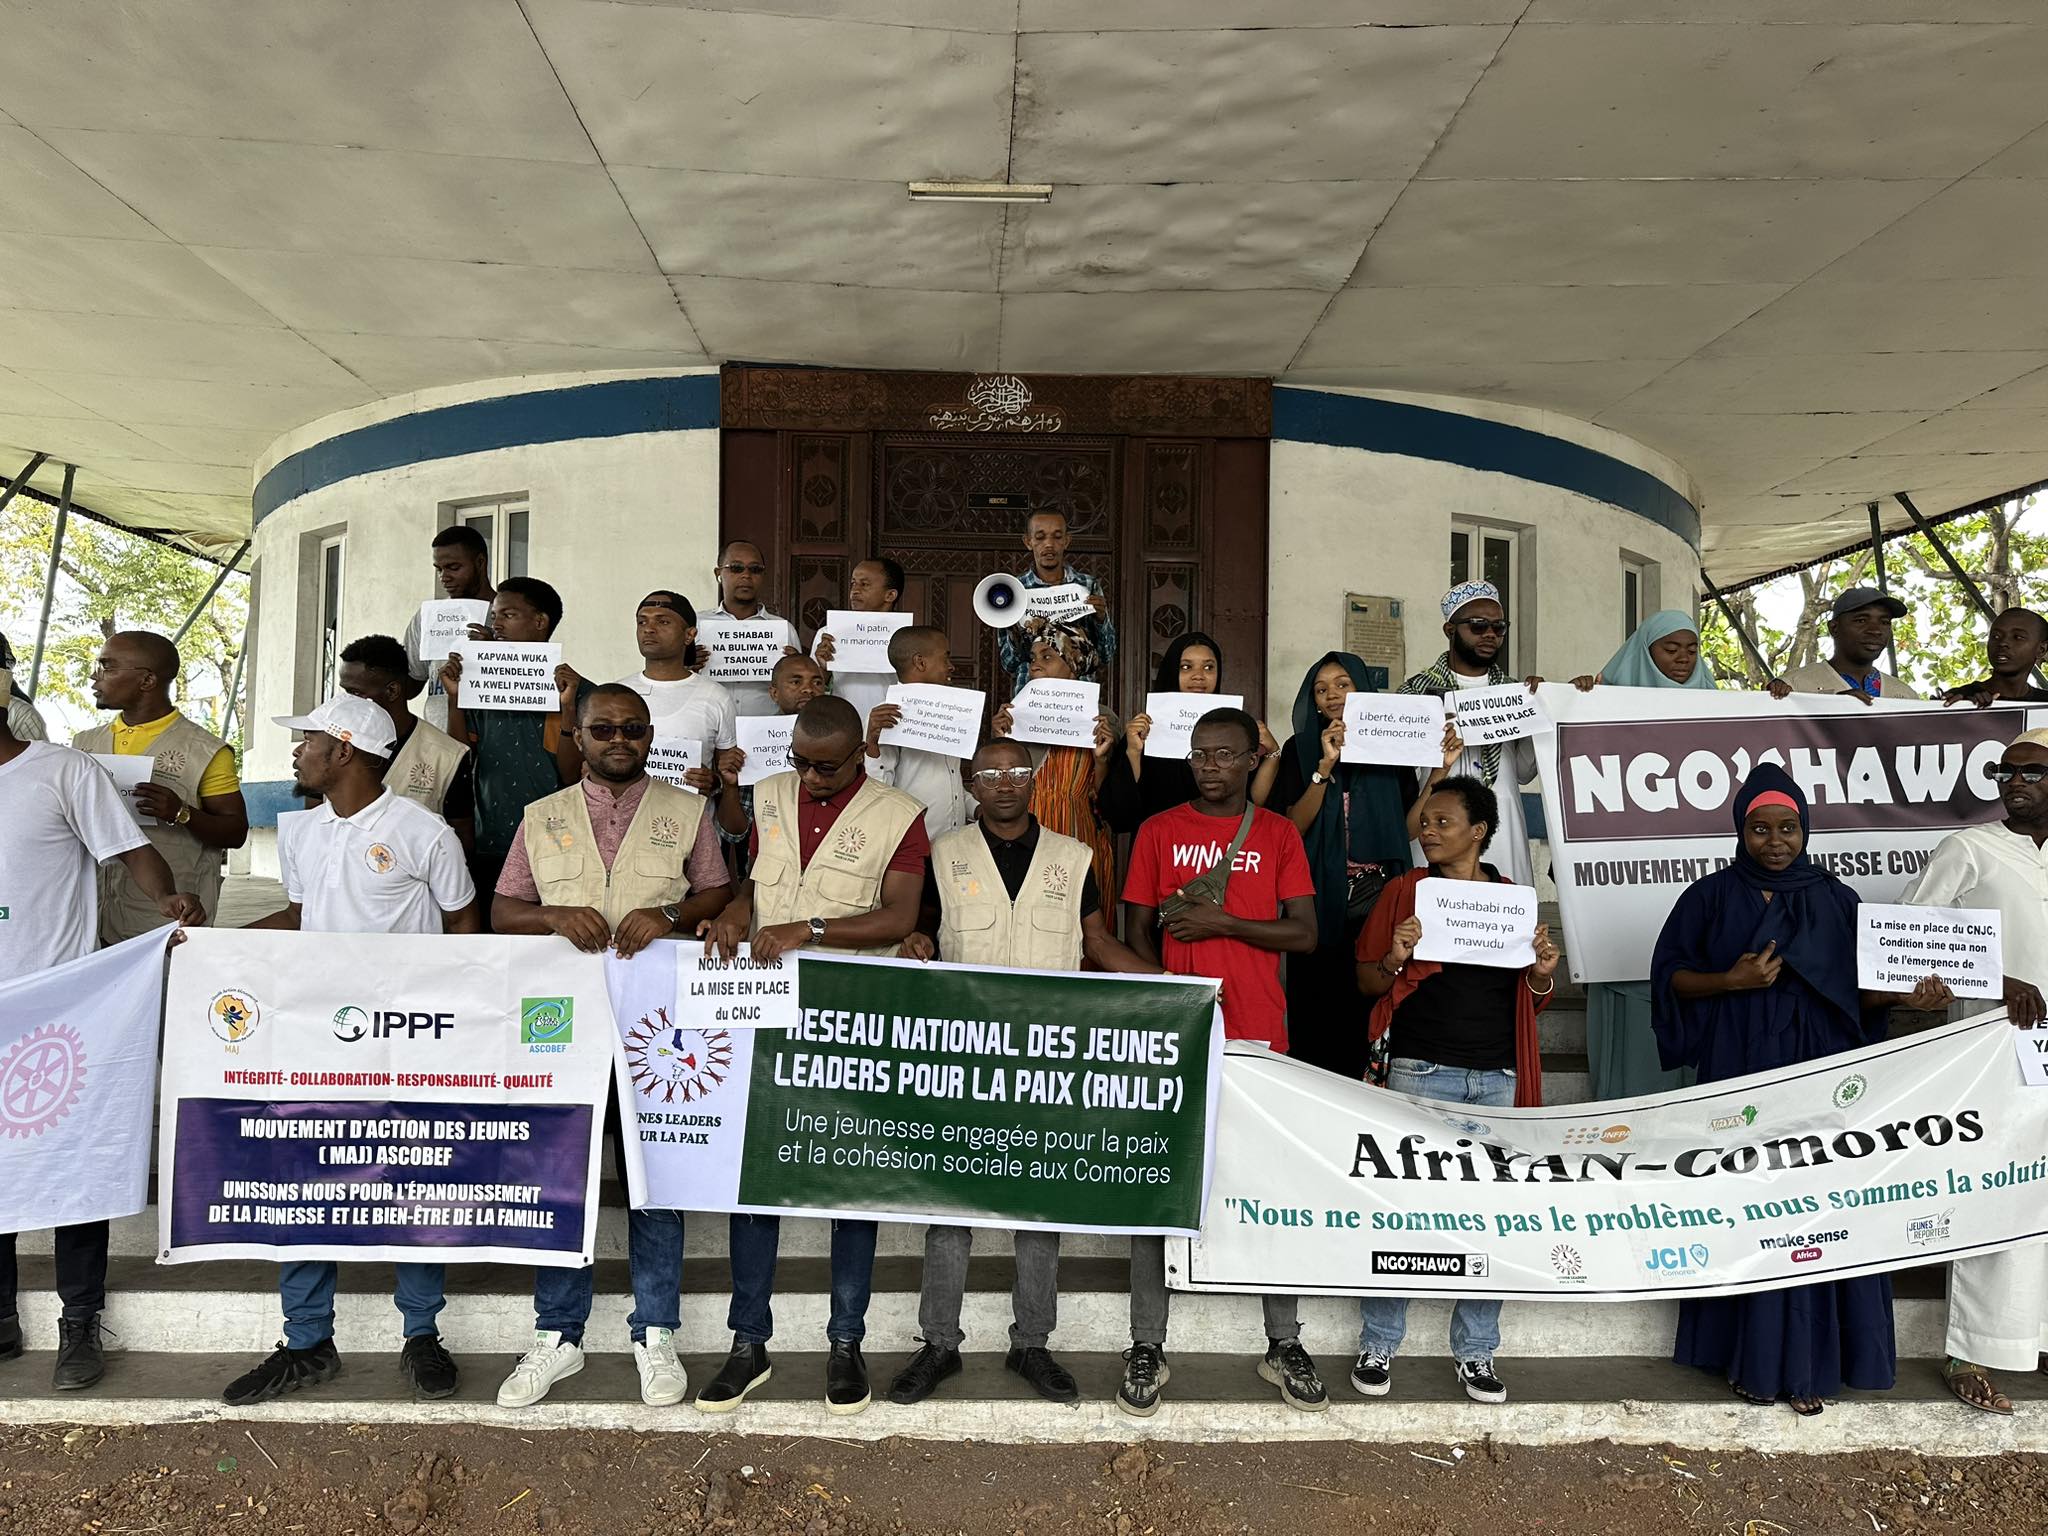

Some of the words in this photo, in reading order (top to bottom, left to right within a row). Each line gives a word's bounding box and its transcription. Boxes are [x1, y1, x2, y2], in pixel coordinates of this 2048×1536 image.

[1036, 597, 1052, 605] QUOI
[1053, 594, 1070, 604] SERT
[1070, 593, 1080, 602] LA
[437, 614, 460, 622] Droits
[430, 628, 454, 636] travail
[856, 623, 865, 632] Ni
[718, 631, 730, 639] YE
[732, 631, 773, 639] SHABABI
[850, 638, 889, 646] marionne
[712, 644, 726, 652] NA
[728, 644, 764, 652] BULIWA
[477, 652, 519, 662] KAPVANA
[521, 654, 548, 663] WUKA
[724, 656, 768, 664] TSANGUE
[480, 666, 545, 677] MAYENDELEYO
[710, 668, 750, 677] HARIMOI
[469, 680, 480, 689] YA
[483, 680, 512, 690] KWELI
[514, 682, 556, 692] PVATSINA
[478, 694, 490, 704] YE
[492, 695, 508, 704] MA
[508, 696, 547, 705] SHABABI
[1030, 688, 1050, 696] Nous
[1051, 690, 1085, 699] sommes
[1028, 700, 1042, 708] des
[1044, 703, 1074, 712] acteurs
[1458, 698, 1482, 713] NOUS
[1482, 694, 1524, 710] VOULONS
[917, 708, 924, 716] la
[924, 711, 954, 722] jeunesse
[1056, 715, 1071, 724] des
[1178, 709, 1198, 720] Stop
[1359, 712, 1396, 724] Liberté,
[1398, 712, 1431, 725] équité
[1456, 718, 1469, 728] LA
[1469, 715, 1492, 728] MISE
[1493, 712, 1507, 725] EN
[1507, 707, 1536, 722] PLACE
[767, 729, 788, 738] Non
[902, 727, 927, 738] affaires
[928, 734, 960, 744] publiques
[940, 724, 956, 733] dans
[958, 726, 967, 735] les
[1028, 725, 1080, 736] observateurs
[1358, 728, 1370, 738] et
[1371, 727, 1426, 740] démocratie
[1482, 732, 1494, 741] du
[1494, 726, 1520, 739] CNJC
[661, 748, 688, 760] WUKA
[644, 760, 686, 772] NDELEYO
[766, 757, 782, 767] des
[1172, 840, 1262, 875] WINNER
[1574, 857, 1711, 887] MOUVEMENT
[1436, 896, 1500, 914] Wushababi
[1502, 904, 1526, 916] ndo
[1446, 918, 1498, 933] twamaya
[1500, 924, 1514, 934] ya
[1870, 919, 1882, 930] La
[1884, 920, 1906, 931] mise
[1910, 922, 1921, 932] en
[1924, 922, 1950, 934] place
[1952, 924, 1964, 934] du
[1966, 925, 1996, 938] CNJC,
[1454, 936, 1504, 950] mawudu
[1879, 936, 1924, 949] Condition
[1926, 939, 1946, 950] sine
[1949, 943, 1966, 953] qua
[1969, 944, 1987, 953] non
[698, 957, 728, 971] NOUS
[1888, 954, 1899, 964] de
[1901, 954, 1960, 969] l'émergence
[1962, 958, 1974, 969] de
[1876, 970, 1885, 980] la
[1939, 976, 1988, 988] omorienne
[690, 982, 705, 996] LA
[708, 982, 734, 996] MISE
[738, 982, 752, 995] EN
[756, 981, 790, 995] PLACE
[715, 1006, 728, 1020] du
[732, 1006, 761, 1020] CNJC
[372, 1011, 455, 1040] IPPF
[892, 1016, 1020, 1057] NATIONAL
[1027, 1023, 1076, 1060] DES
[1082, 1027, 1180, 1066] JEUNES
[224, 1044, 240, 1056] MAJ
[529, 1044, 567, 1054] ASCOBEF
[224, 1068, 288, 1085] INTÉGRITÉ-
[290, 1072, 394, 1086] COLLABORATION-
[396, 1072, 501, 1088] RESPONSABILITÉ-
[503, 1072, 554, 1090] QUALITÉ
[774, 1052, 891, 1093] LEADERS
[897, 1061, 965, 1100] POUR
[972, 1066, 1007, 1102] LA
[1014, 1068, 1076, 1106] PAIX
[1082, 1070, 1184, 1114] (RNJLP)
[636, 1112, 663, 1124] NES
[665, 1113, 722, 1128] LEADERS
[240, 1118, 347, 1139] MOUVEMENT
[350, 1119, 430, 1140] D'ACTION
[433, 1120, 466, 1140] DES
[468, 1121, 530, 1141] JEUNES
[785, 1107, 828, 1134] Une
[831, 1110, 935, 1140] jeunesse
[942, 1124, 1038, 1152] engagée
[1044, 1130, 1096, 1154] pour
[1102, 1128, 1119, 1153] la
[1126, 1132, 1170, 1159] paix
[640, 1130, 658, 1142] UR
[660, 1131, 677, 1142] LA
[679, 1132, 709, 1144] PAIX
[376, 1145, 454, 1166] ASCOBEF
[778, 1140, 802, 1163] et
[808, 1139, 826, 1164] la
[832, 1142, 936, 1171] cohésion
[942, 1152, 1023, 1178] sociale
[1029, 1160, 1068, 1181] aux
[1074, 1157, 1171, 1184] Comores
[222, 1180, 300, 1202] UNISSONS
[302, 1182, 346, 1202] NOUS
[349, 1183, 394, 1202] POUR
[396, 1180, 542, 1204] L'ÉPANOUISSEMENT
[1225, 1198, 1314, 1228] "Nous
[1325, 1209, 1360, 1228] ne
[1372, 1210, 1486, 1232] sommes
[1494, 1212, 1543, 1237] pas
[1549, 1206, 1577, 1232] le
[1585, 1202, 1735, 1236] problème,
[1742, 1194, 1819, 1222] nous
[1828, 1179, 1938, 1210] sommes
[1946, 1168, 1972, 1195] la
[1982, 1154, 2048, 1190] soluti
[208, 1204, 230, 1224] DE
[232, 1205, 252, 1224] LA
[254, 1206, 326, 1226] JEUNESSE
[331, 1207, 350, 1225] ET
[352, 1207, 369, 1225] LE
[372, 1204, 450, 1226] BIEN-ÊTRE
[452, 1208, 473, 1226] DE
[475, 1208, 496, 1226] LA
[497, 1208, 554, 1230] FAMILLE
[1908, 1220, 1934, 1232] JEUNES
[1913, 1227, 1950, 1240] REPORTERS
[1645, 1247, 1688, 1270] JCI
[1796, 1251, 1818, 1260] Africa
[1376, 1256, 1462, 1273] NGO'SHAWO
[1661, 1269, 1697, 1277] Comores
